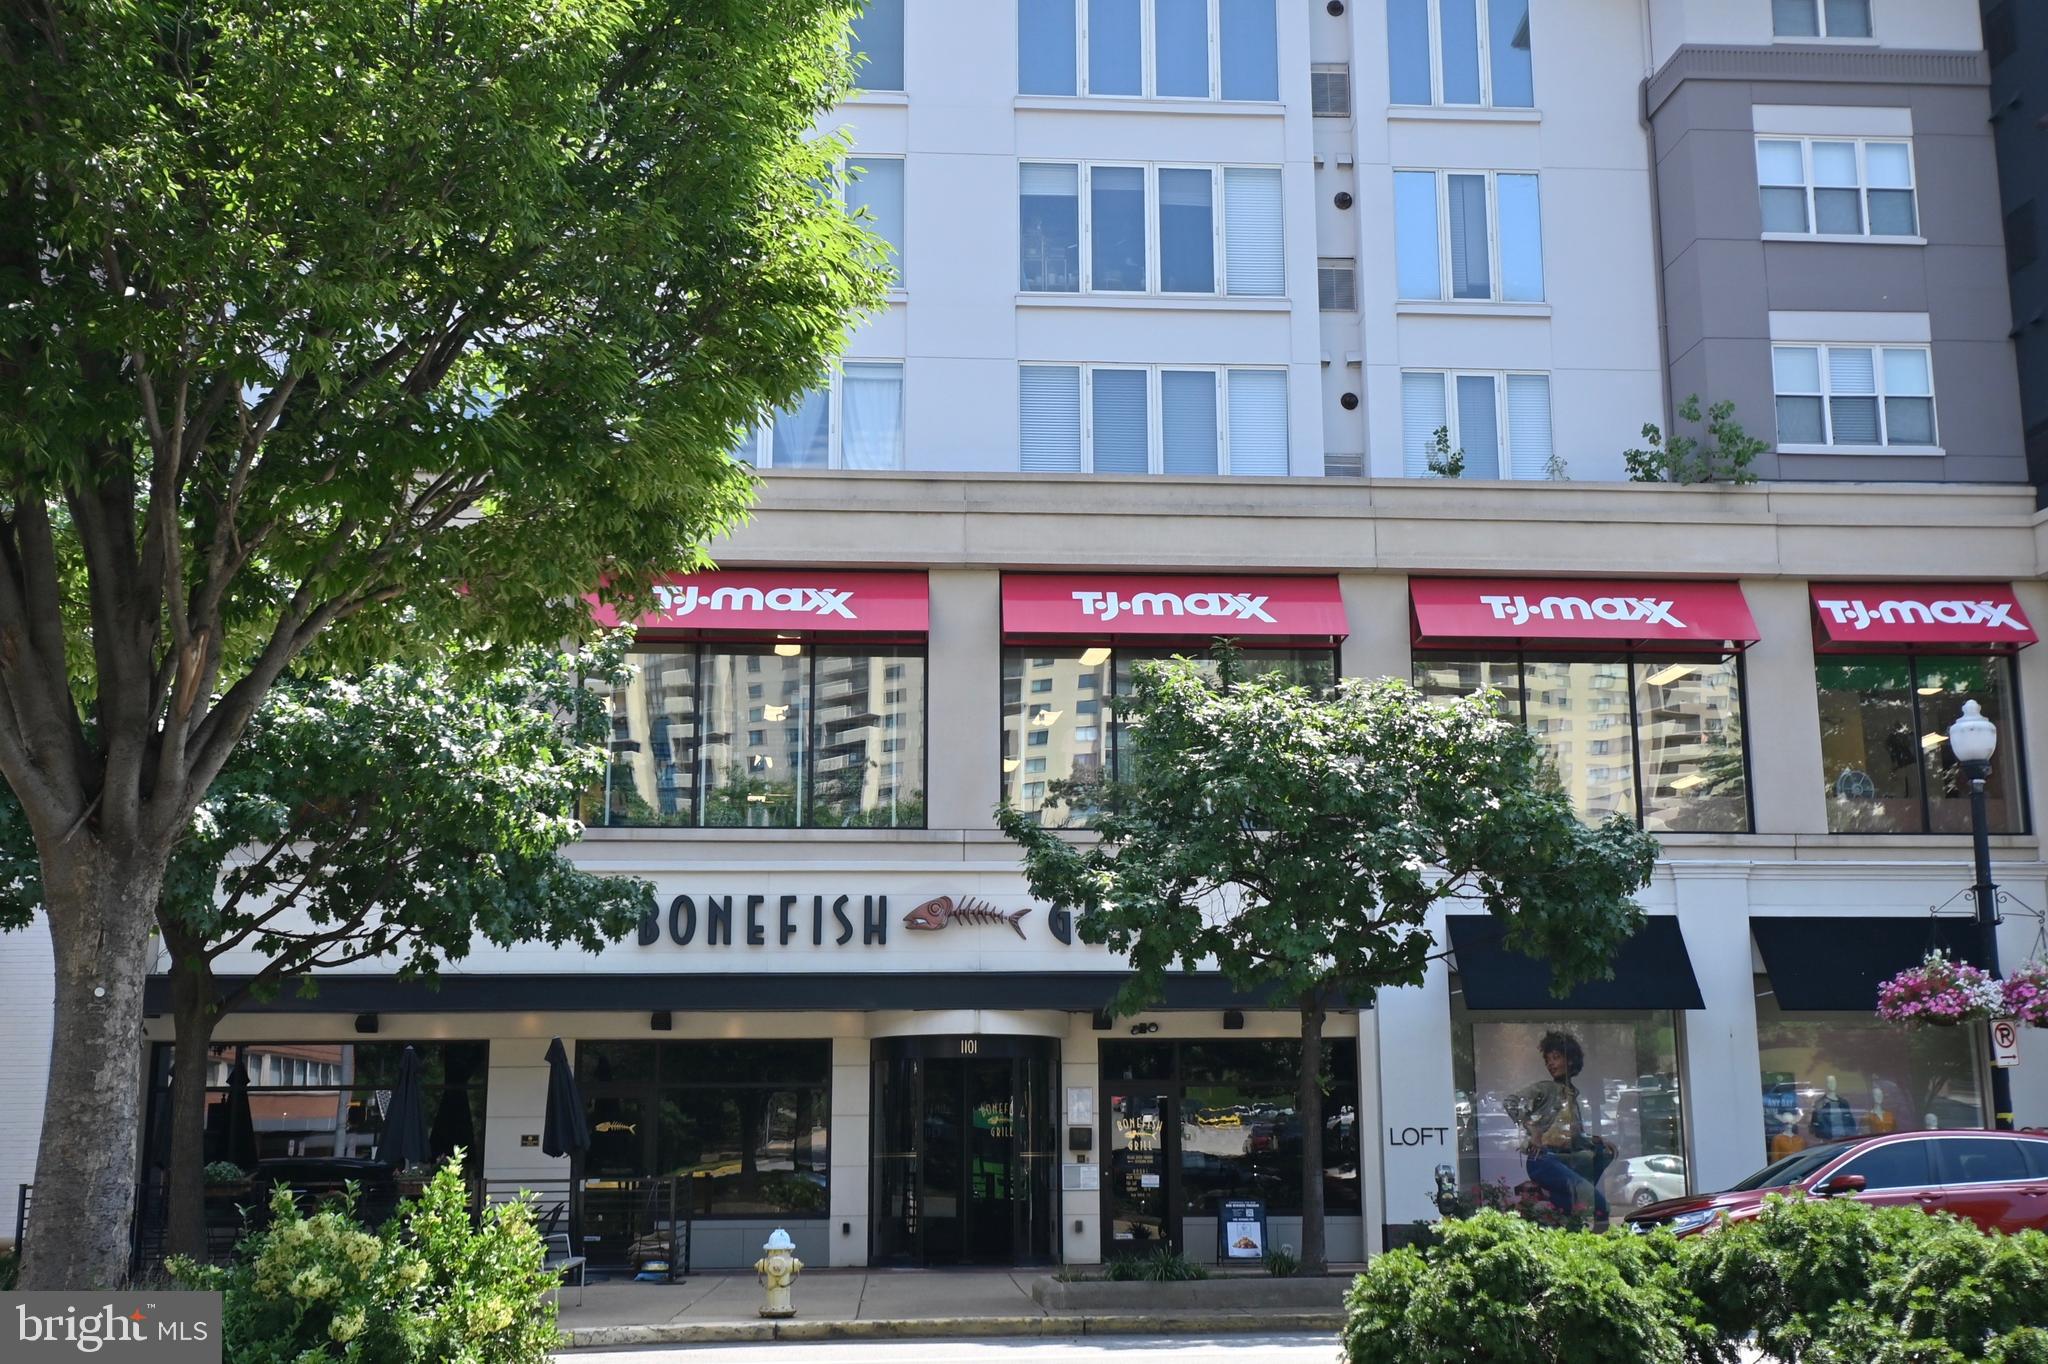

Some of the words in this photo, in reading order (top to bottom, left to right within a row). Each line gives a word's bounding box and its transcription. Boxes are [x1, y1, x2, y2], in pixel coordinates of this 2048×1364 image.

[638, 894, 887, 946] BONEFISH
[961, 1039, 977, 1054] 1101
[1116, 1116, 1163, 1131] BONEFISH
[990, 1126, 1014, 1137] GRILL
[1390, 1127, 1449, 1146] LOFT
[1127, 1140, 1152, 1151] GRILL
